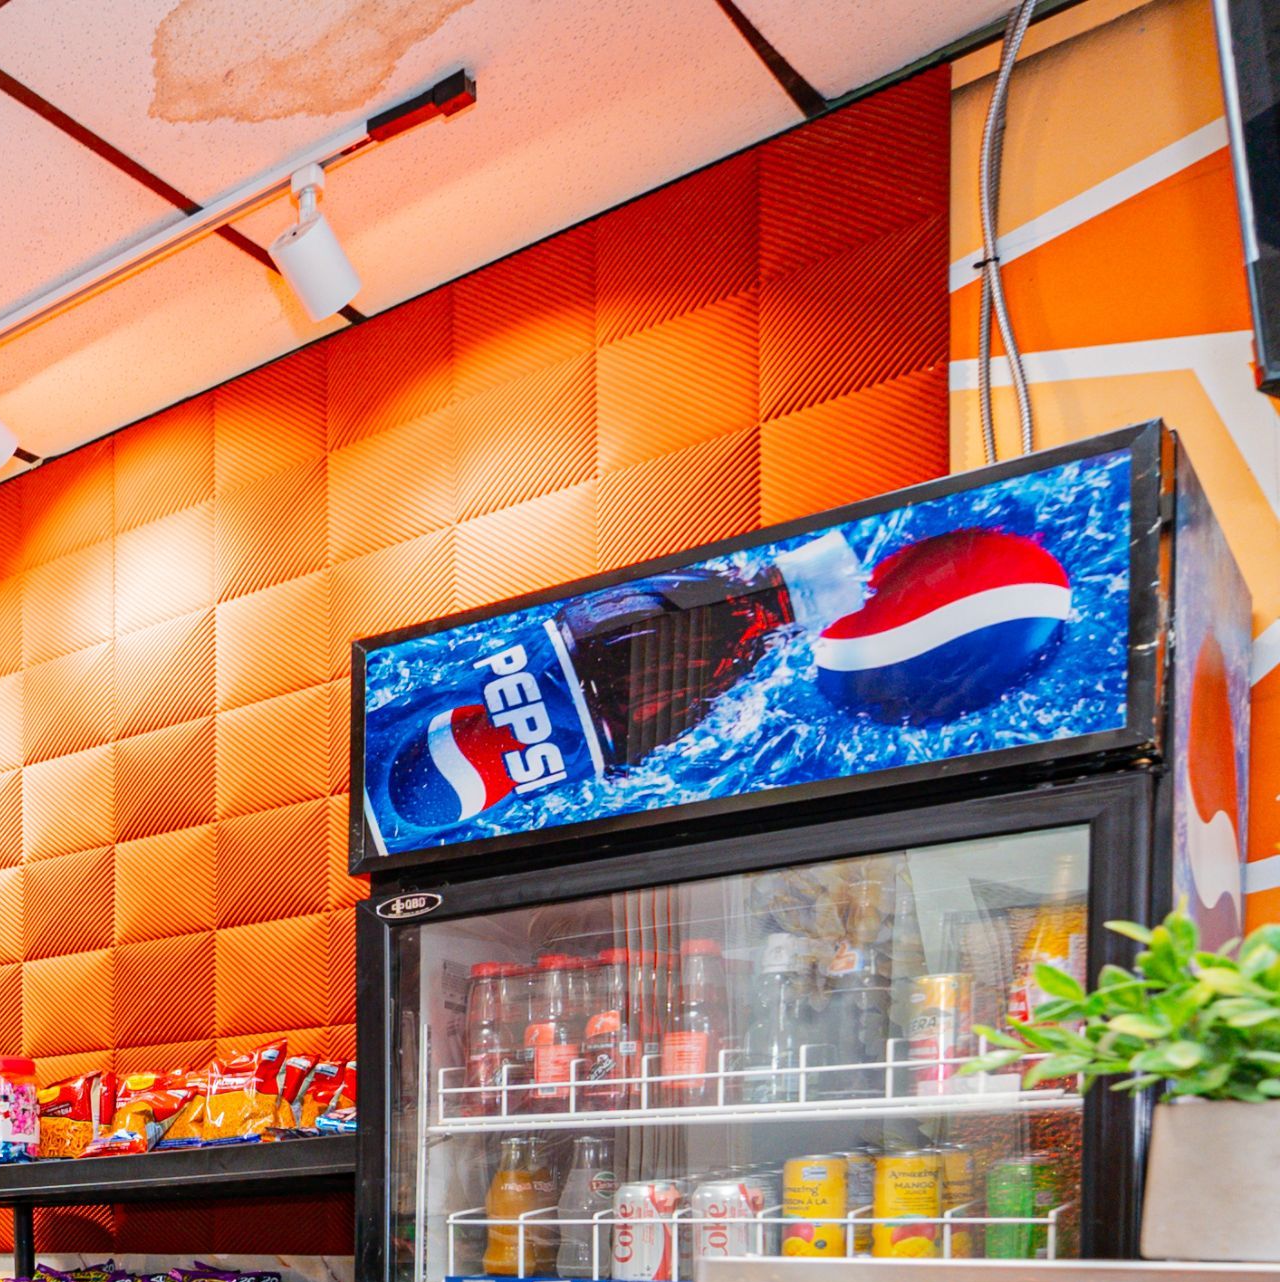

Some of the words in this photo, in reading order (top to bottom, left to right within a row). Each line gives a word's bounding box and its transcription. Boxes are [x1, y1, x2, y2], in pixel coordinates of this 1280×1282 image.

[474, 644, 568, 795] PEPSI
[614, 1202, 635, 1263] Coke
[704, 1201, 729, 1257] oke
